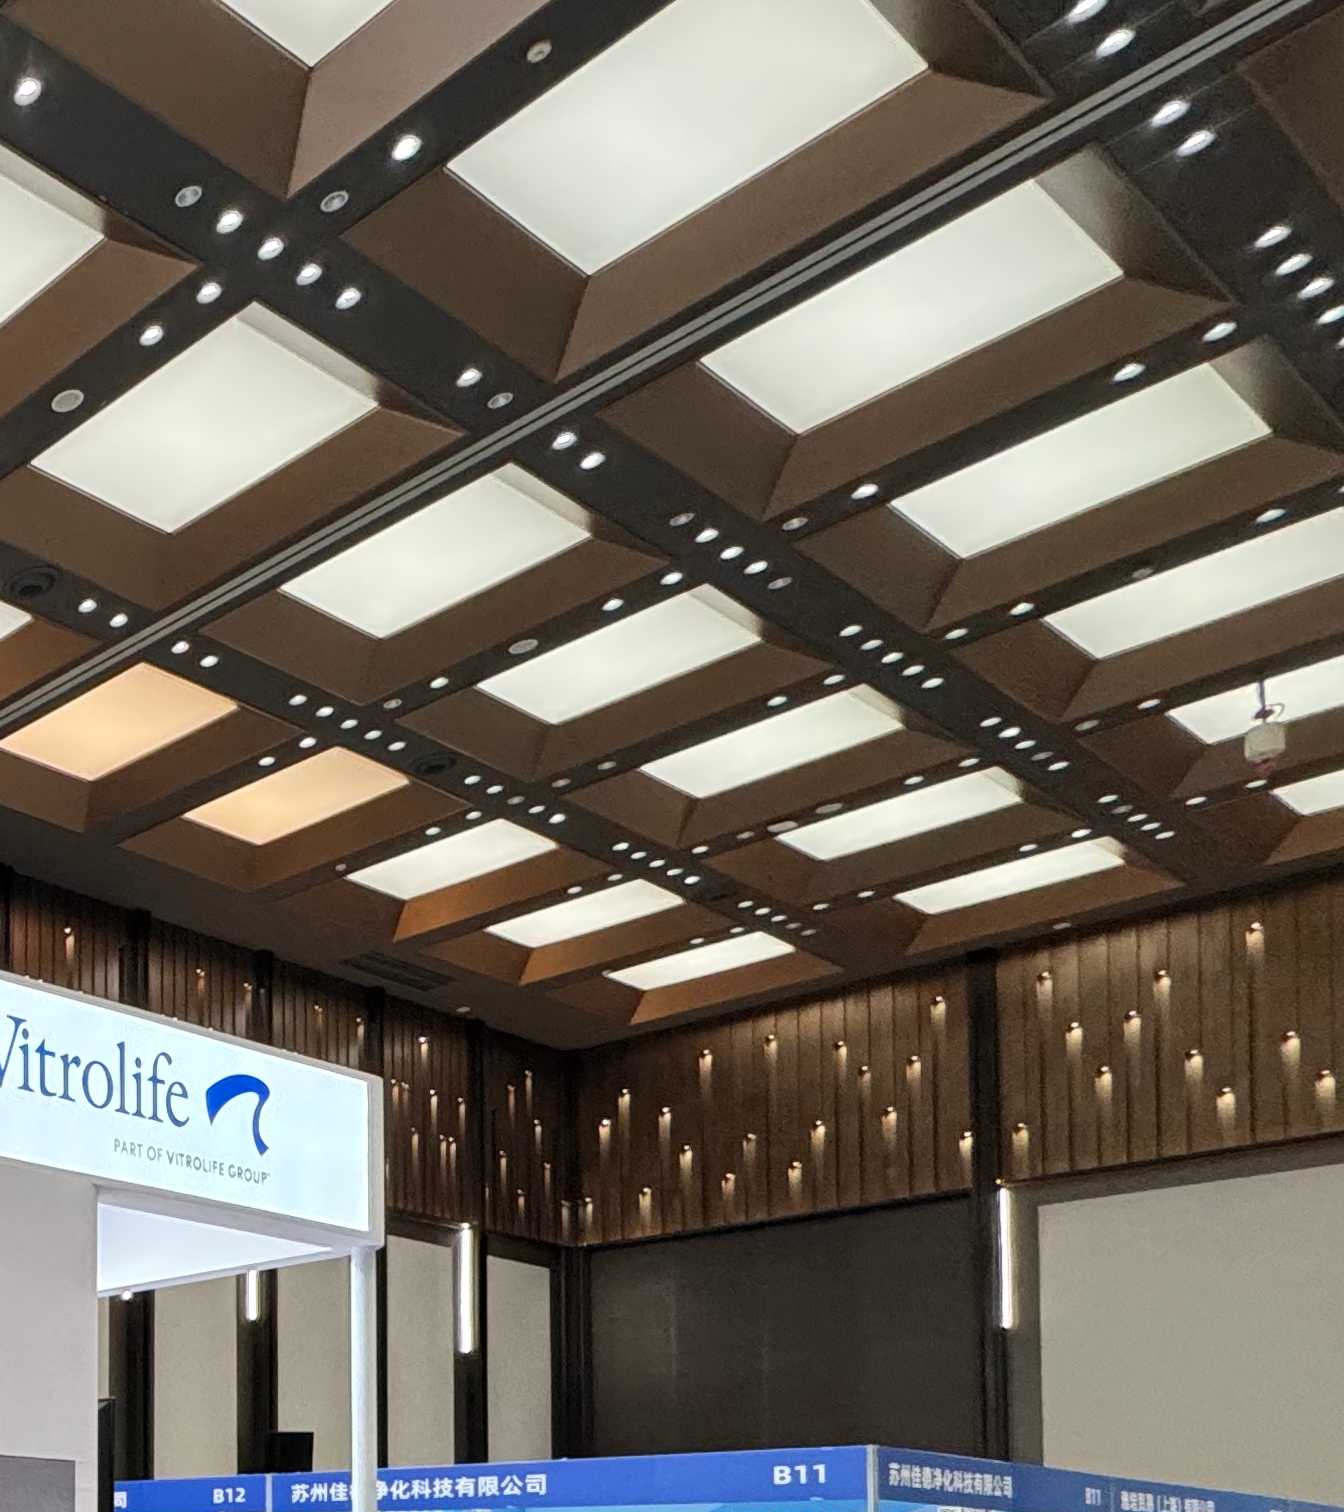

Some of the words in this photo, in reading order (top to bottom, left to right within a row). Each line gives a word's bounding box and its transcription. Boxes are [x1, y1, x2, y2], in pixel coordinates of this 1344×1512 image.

[113, 1138, 144, 1161] PART
[146, 1146, 163, 1161] OF
[166, 1150, 225, 1177] VITROLIFE
[228, 1164, 269, 1185] GROUP
[772, 1463, 827, 1486] B11
[212, 1487, 246, 1503] B12
[290, 1473, 548, 1504] 苏州佳净化科技有限公司
